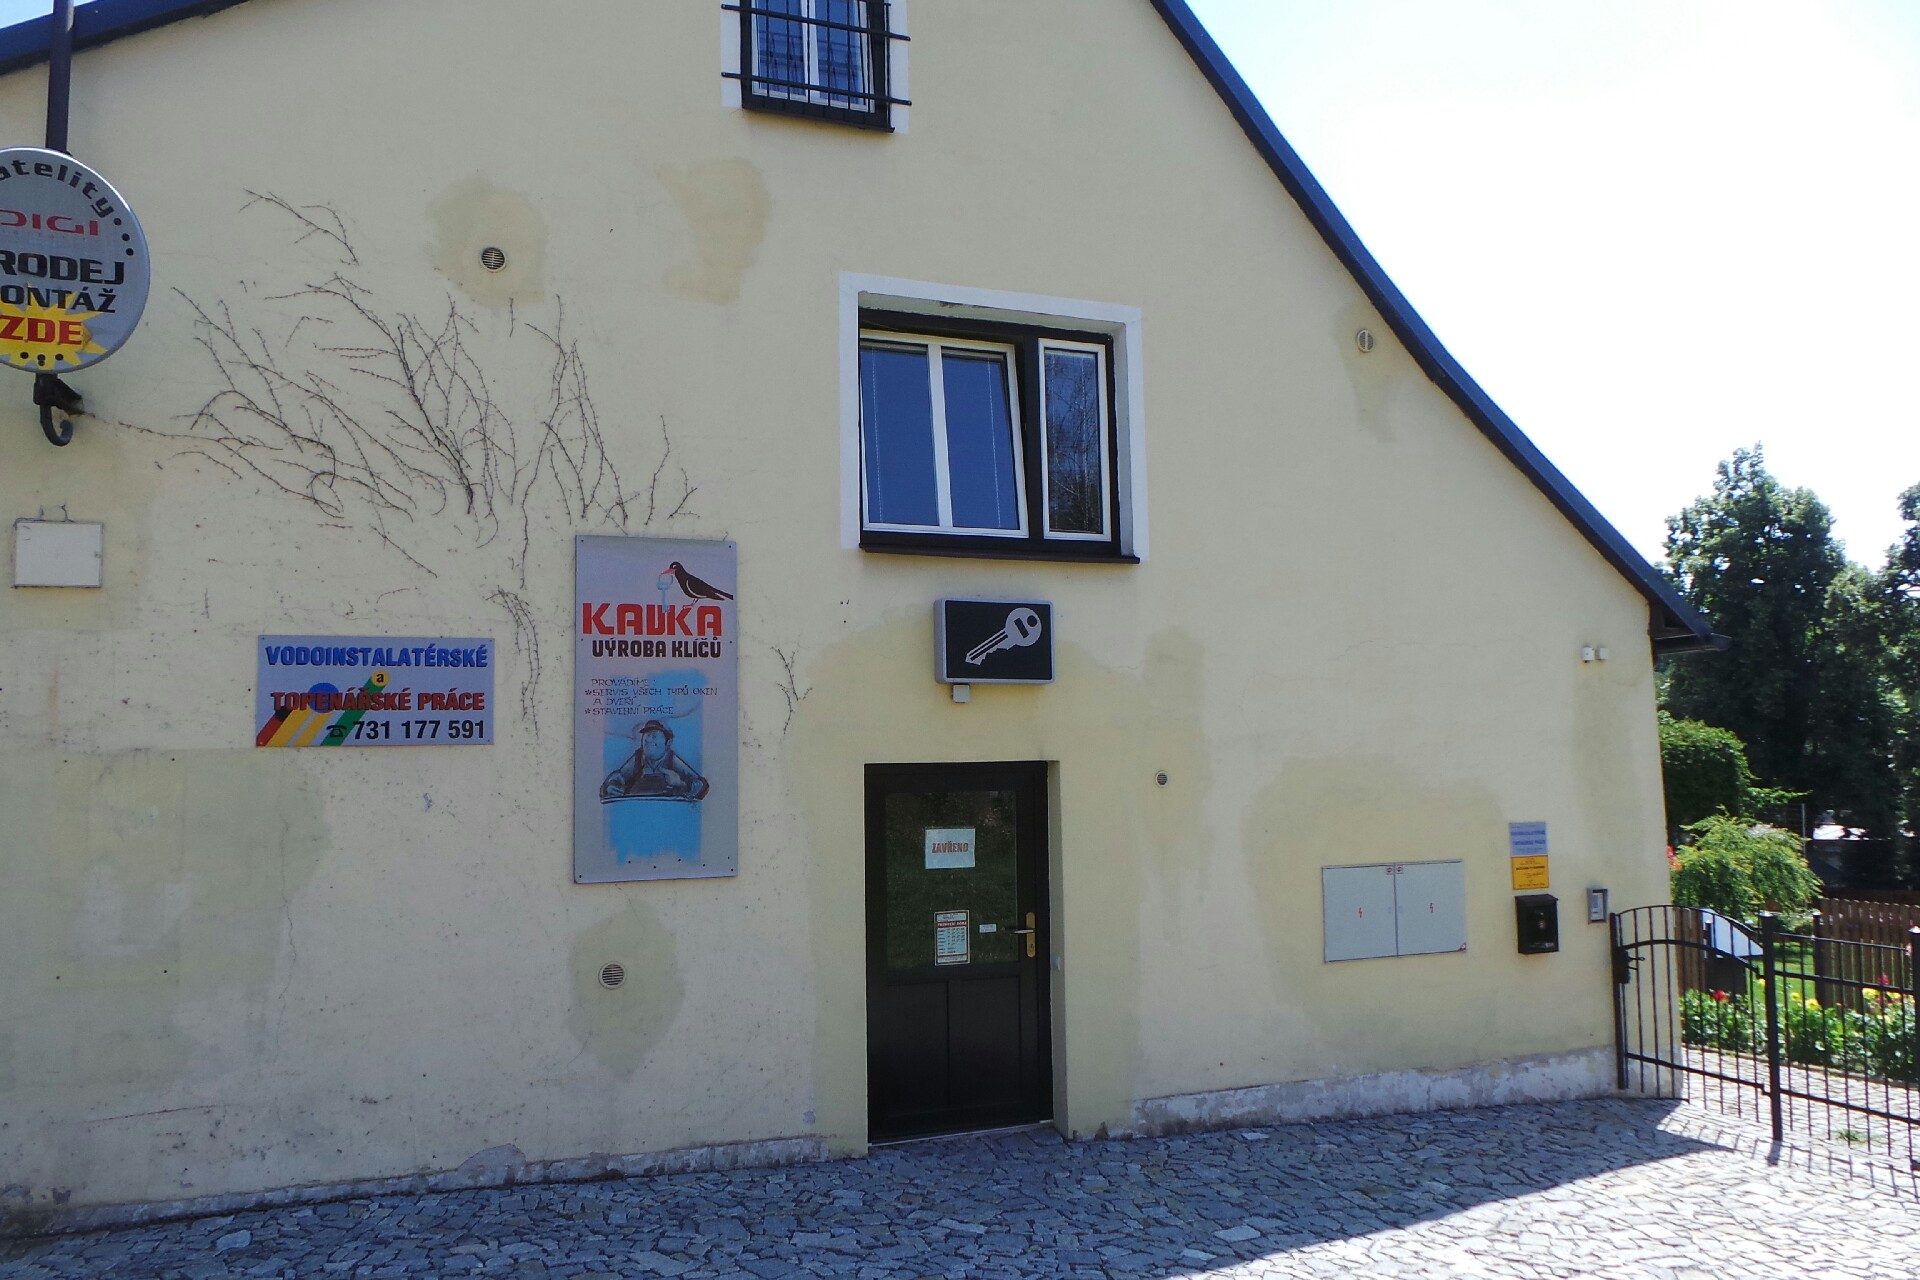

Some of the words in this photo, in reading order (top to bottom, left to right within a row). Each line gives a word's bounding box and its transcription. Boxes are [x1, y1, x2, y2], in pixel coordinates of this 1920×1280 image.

[0, 209, 98, 236] DIGI
[0, 250, 125, 285] RODEJ
[0, 285, 117, 313] ONTÁŽ
[0, 315, 82, 345] ZDE
[583, 603, 722, 636] KAVKA
[265, 643, 488, 668] VODOINSTALATÉRSKÉ
[592, 638, 667, 657] VÝROBA
[671, 637, 721, 657] KLÍČŮ
[376, 671, 385, 683] a
[270, 687, 411, 711] TOPENÁŘSKÉ
[417, 687, 485, 711] PRÁCE
[592, 698, 602, 706] A
[632, 686, 662, 696] VŠECH
[692, 687, 718, 696] OKEN
[643, 705, 674, 715] PRÁCE
[353, 720, 391, 740] 731
[401, 720, 441, 739] 177
[447, 720, 485, 739] 591
[931, 841, 969, 854] ZAVŘENO
